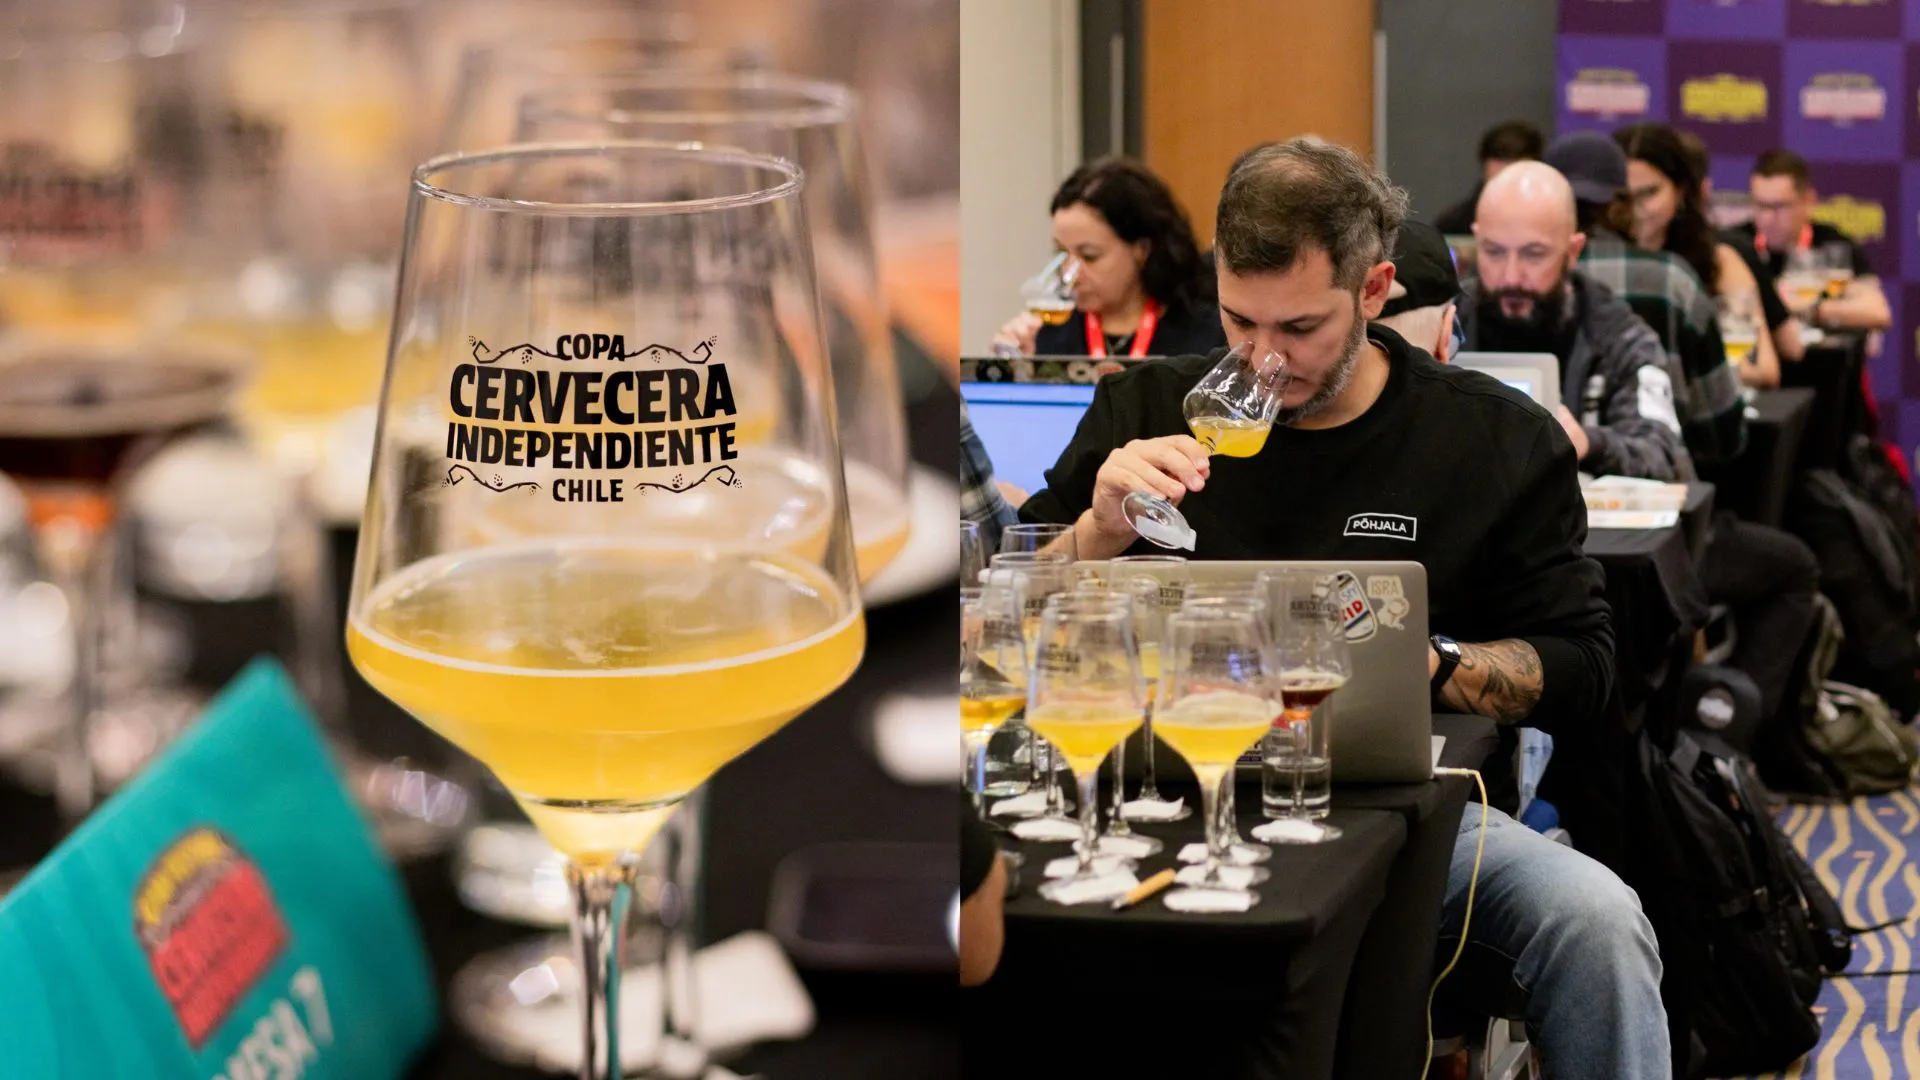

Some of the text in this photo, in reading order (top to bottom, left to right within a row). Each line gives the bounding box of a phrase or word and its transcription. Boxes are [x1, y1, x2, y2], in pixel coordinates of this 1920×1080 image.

[556, 334, 625, 361] COPA
[450, 363, 737, 425] CERVECERA
[446, 422, 738, 469] INDEPENDIENTE
[552, 478, 624, 502] CHILE
[1353, 517, 1407, 533] PÕHJALA
[1371, 579, 1399, 596] ISRA
